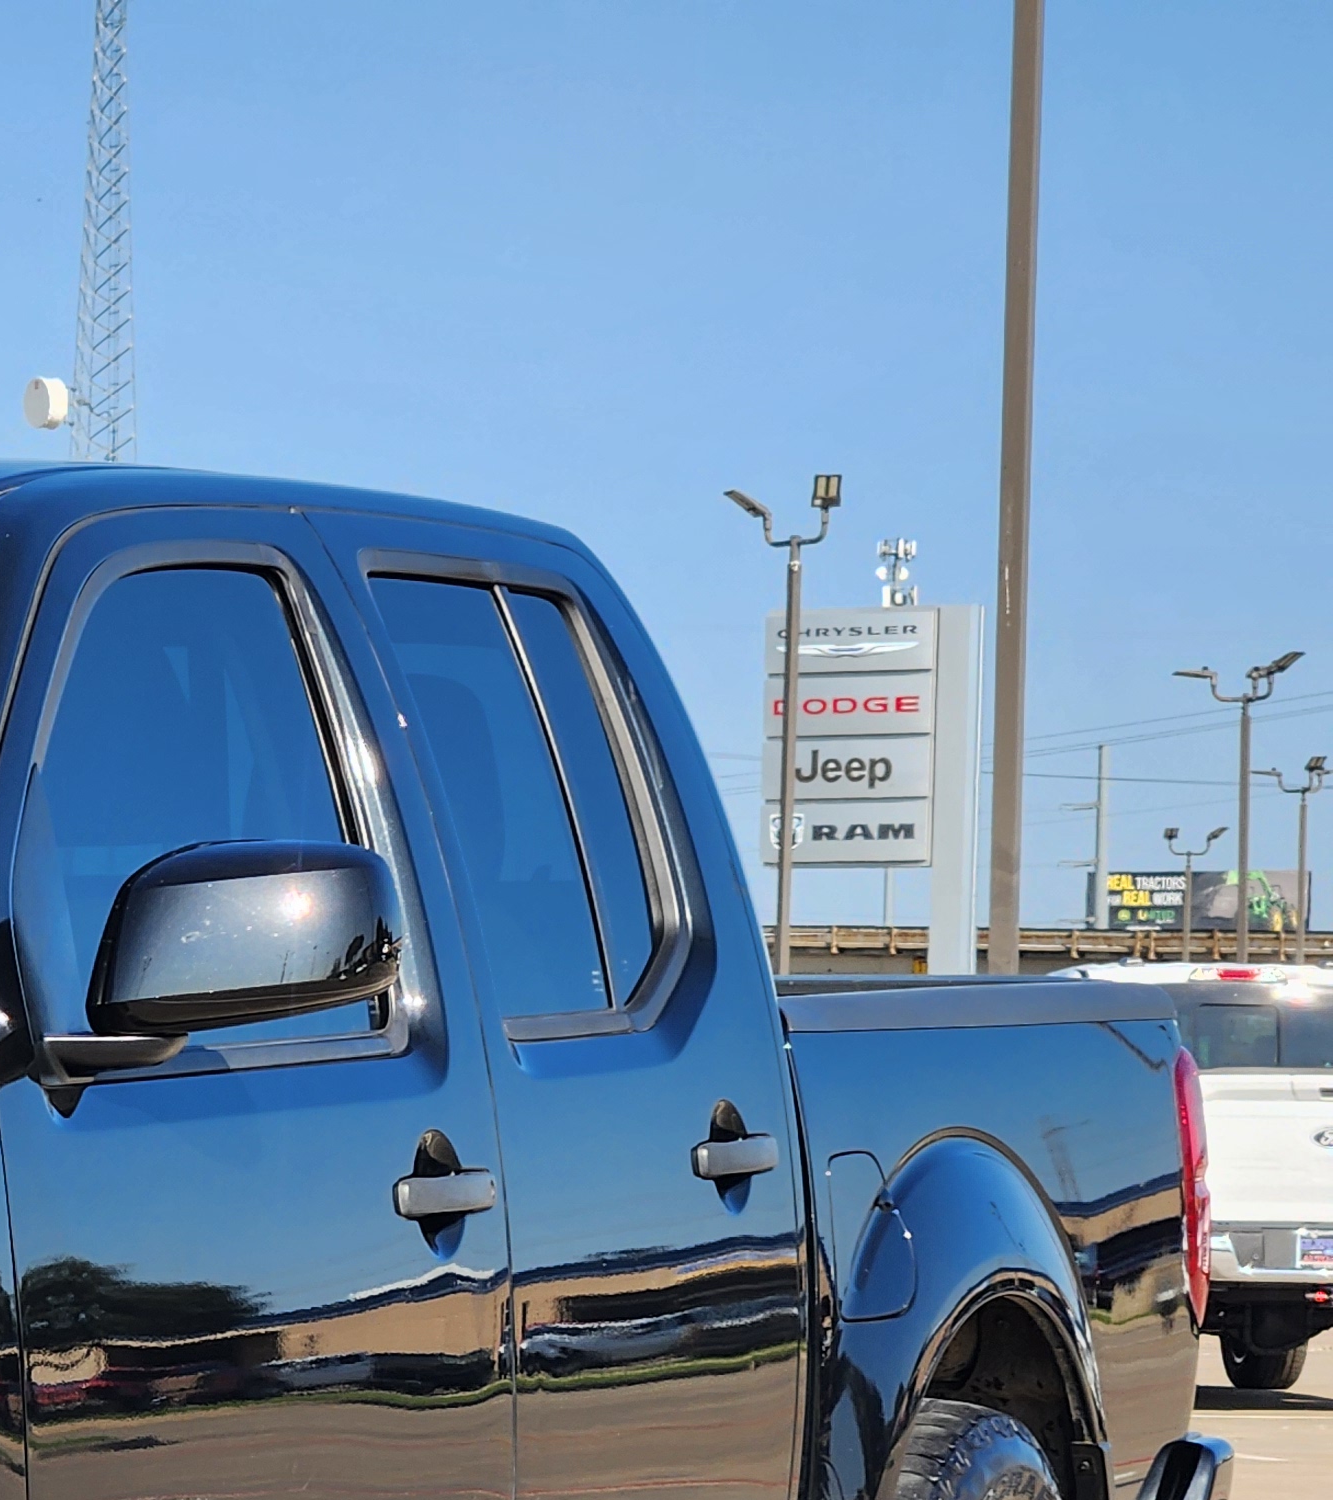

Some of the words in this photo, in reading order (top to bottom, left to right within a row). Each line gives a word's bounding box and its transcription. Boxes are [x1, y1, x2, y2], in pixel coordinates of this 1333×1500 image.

[795, 749, 893, 789] Jeep
[812, 823, 916, 841] RAM
[1107, 874, 1134, 890] REAL
[1135, 875, 1186, 890] TRACTORS
[1122, 890, 1152, 906] REAL
[1152, 891, 1183, 906] WORK
